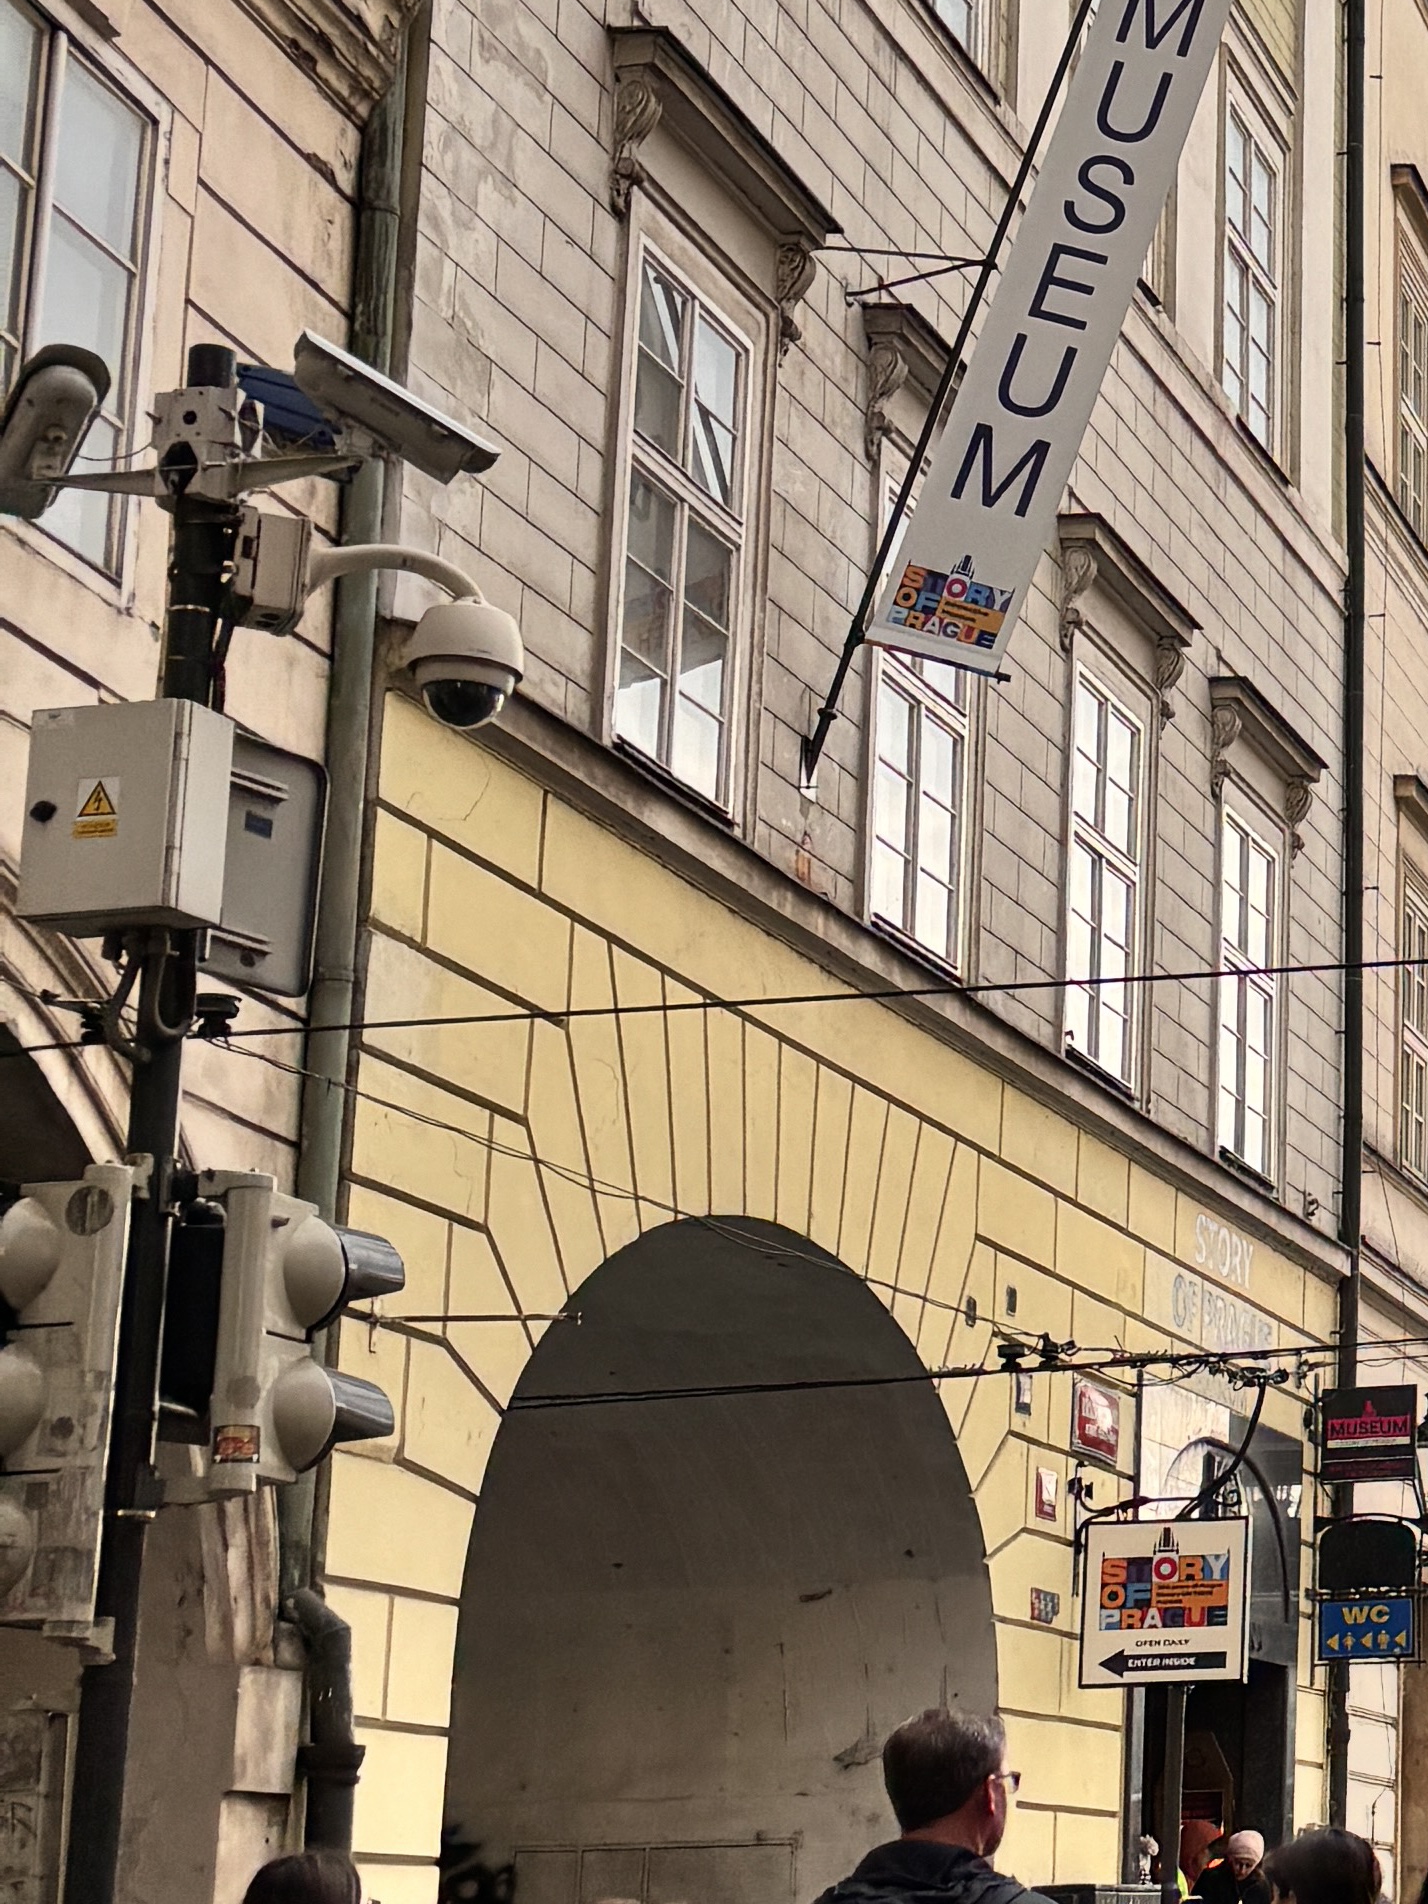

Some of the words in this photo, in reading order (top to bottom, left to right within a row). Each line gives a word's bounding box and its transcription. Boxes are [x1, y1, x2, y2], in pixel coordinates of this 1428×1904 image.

[1330, 1417, 1408, 1437] MUSEUM
[1102, 1553, 1229, 1583] STORY
[1101, 1583, 1151, 1607] OF
[1100, 1606, 1228, 1631] PRAGUE
[1342, 1604, 1390, 1625] WC
